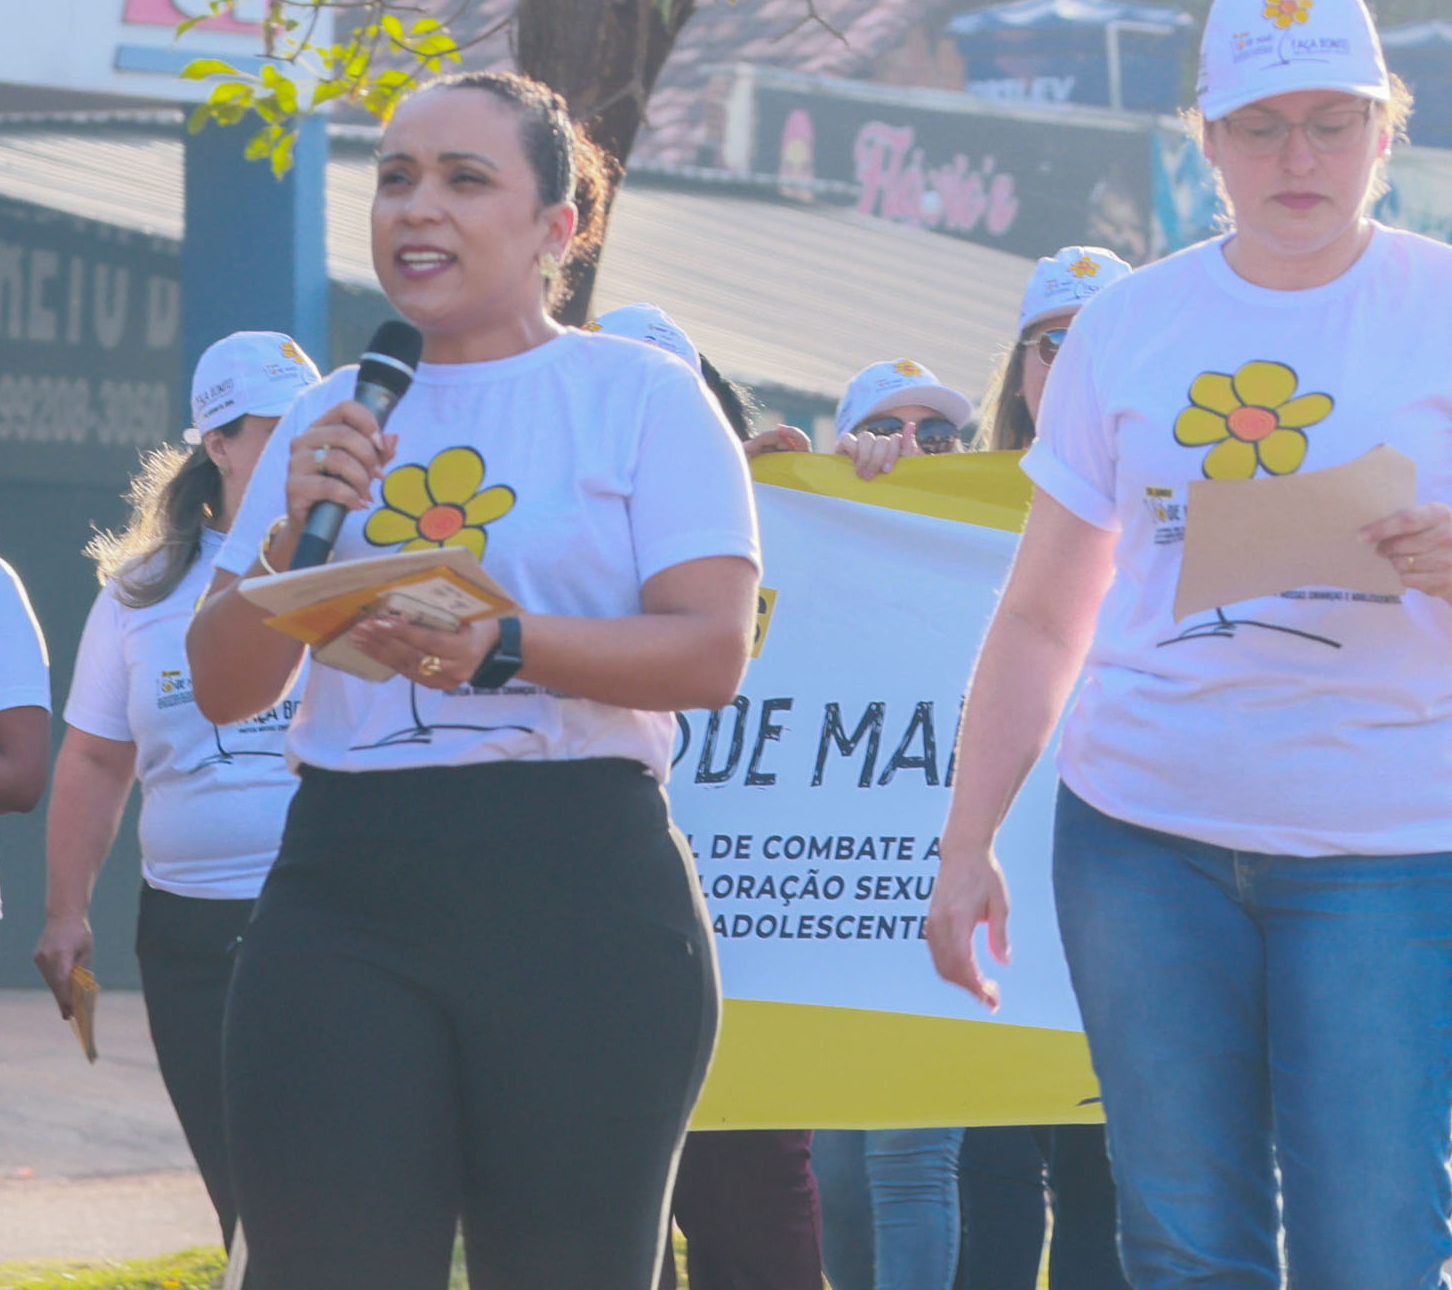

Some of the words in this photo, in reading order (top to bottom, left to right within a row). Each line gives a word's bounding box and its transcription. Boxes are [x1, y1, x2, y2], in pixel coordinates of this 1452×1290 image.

[695, 694, 794, 789] DE
[811, 694, 966, 788] MA
[711, 835, 753, 859] DE
[763, 835, 915, 860] COMBATE
